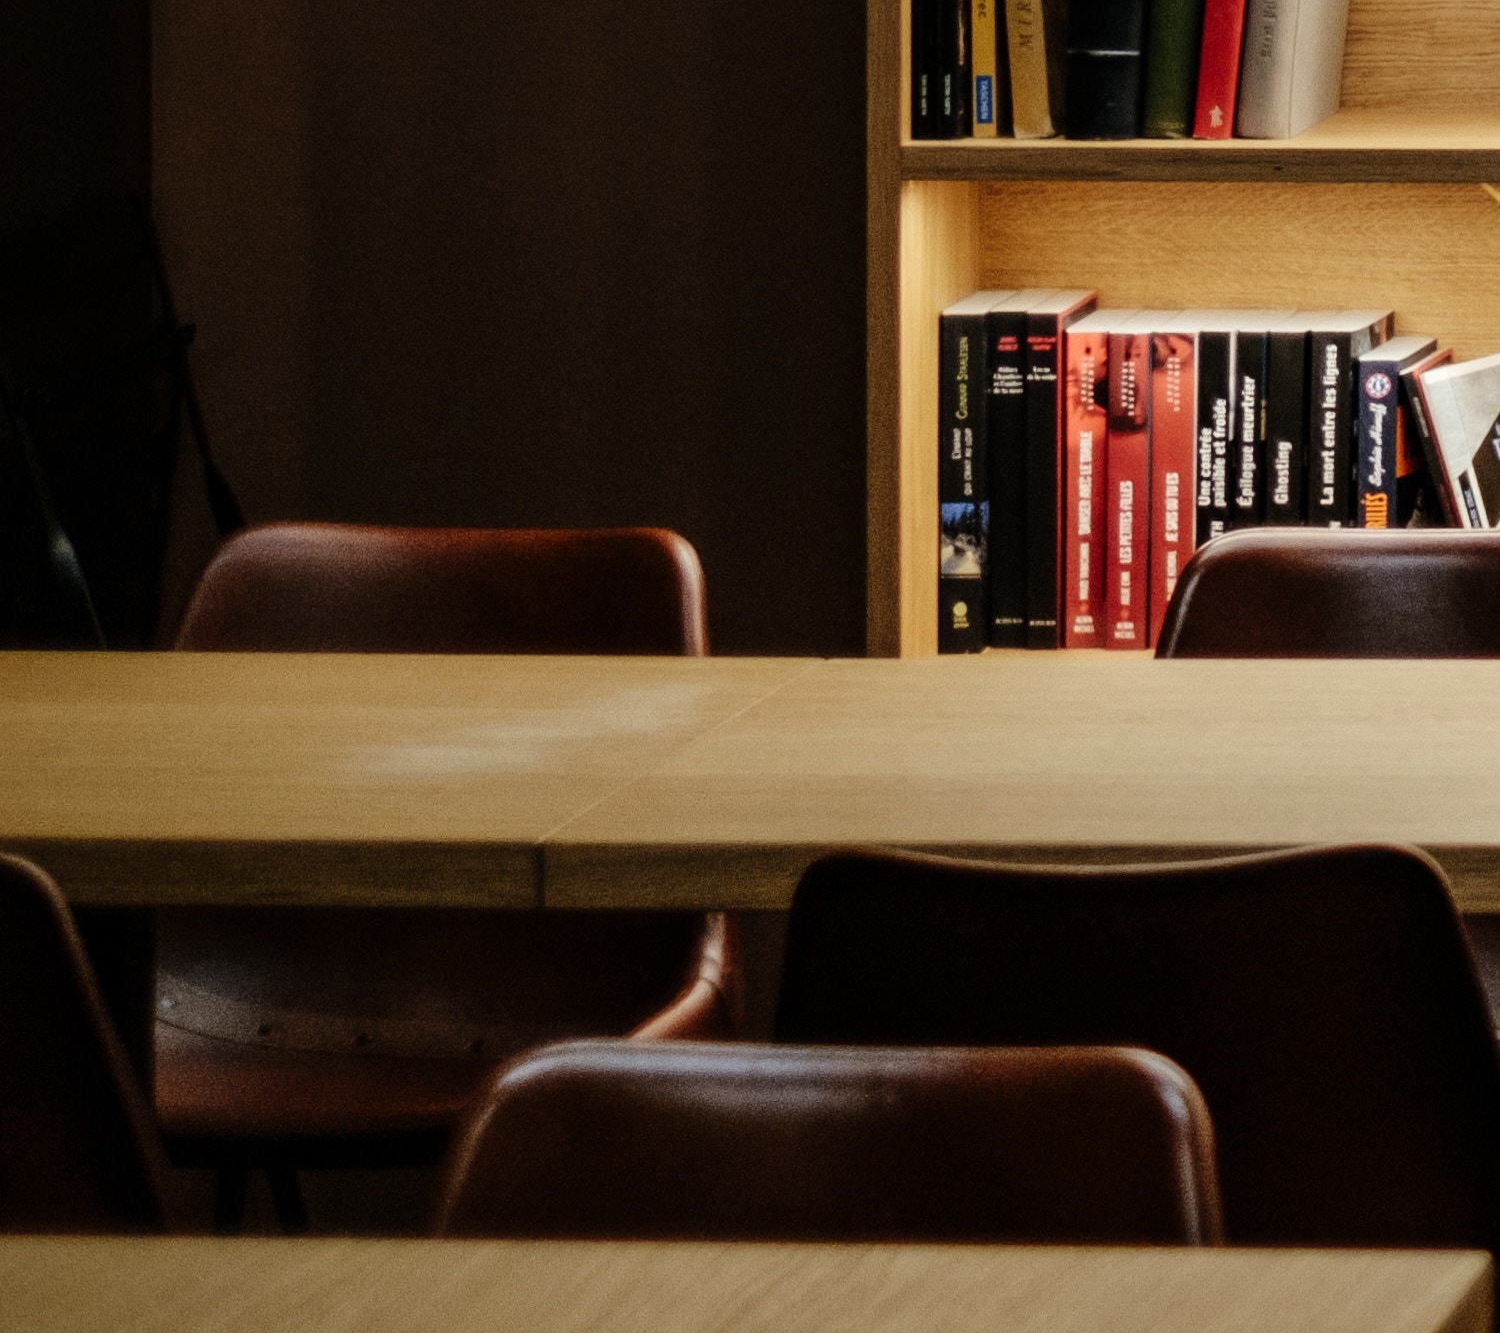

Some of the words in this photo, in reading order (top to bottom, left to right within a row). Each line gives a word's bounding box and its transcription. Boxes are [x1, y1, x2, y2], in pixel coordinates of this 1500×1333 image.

[1323, 344, 1339, 385] lignes
[1242, 376, 1255, 441] meurtrier
[1323, 388, 1336, 406] les
[1322, 410, 1336, 447] entre
[1236, 447, 1253, 508] Épilogue
[1274, 441, 1293, 505] Ghosting
[1321, 452, 1335, 482] mort
[1320, 487, 1334, 505] La
